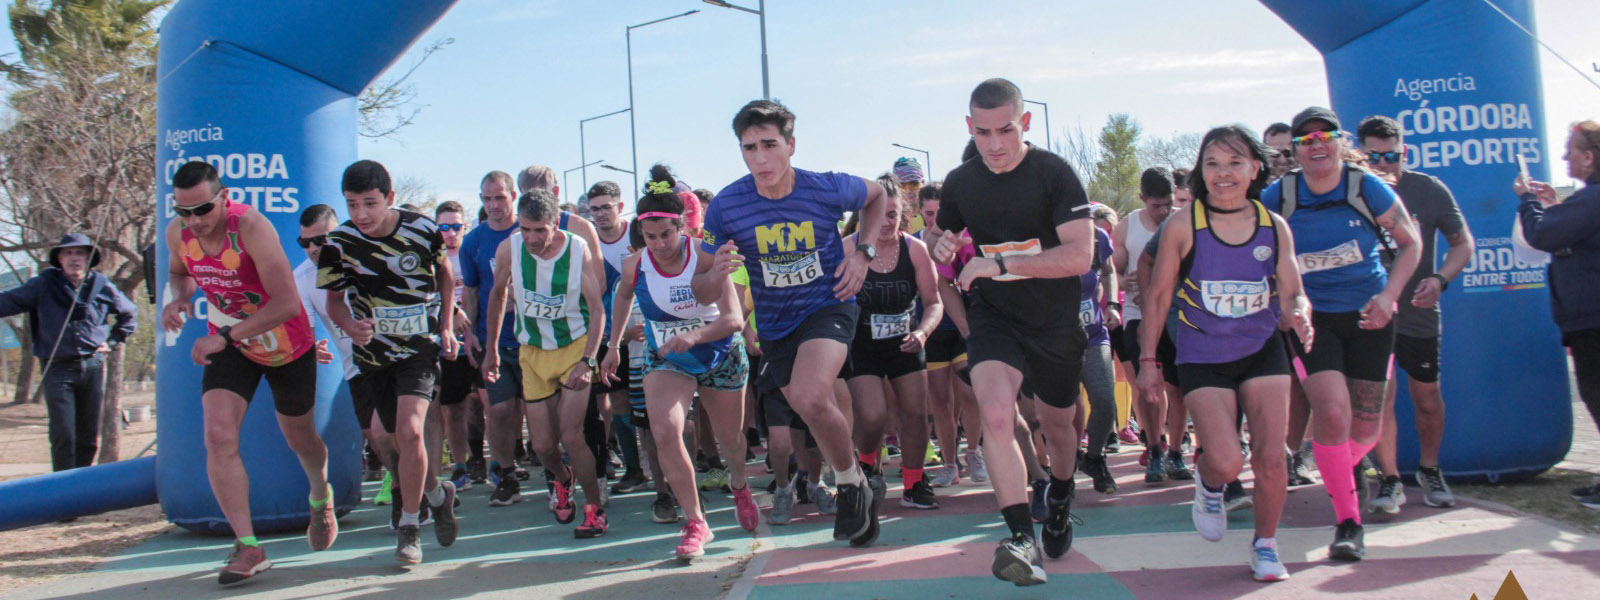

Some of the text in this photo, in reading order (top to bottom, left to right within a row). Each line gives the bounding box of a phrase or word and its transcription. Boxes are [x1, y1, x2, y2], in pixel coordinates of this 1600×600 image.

[1394, 73, 1476, 101] Agencia
[1397, 100, 1533, 136] CÓRDOBA
[164, 123, 224, 151] Agencia
[1404, 137, 1541, 170] DEPORTES
[1303, 250, 1359, 269] 6723
[769, 264, 817, 285] 7116
[1463, 270, 1545, 287] ENTRE TODOS
[524, 301, 562, 318] 7127
[1209, 294, 1264, 314] 7114
[378, 316, 423, 333] 6741
